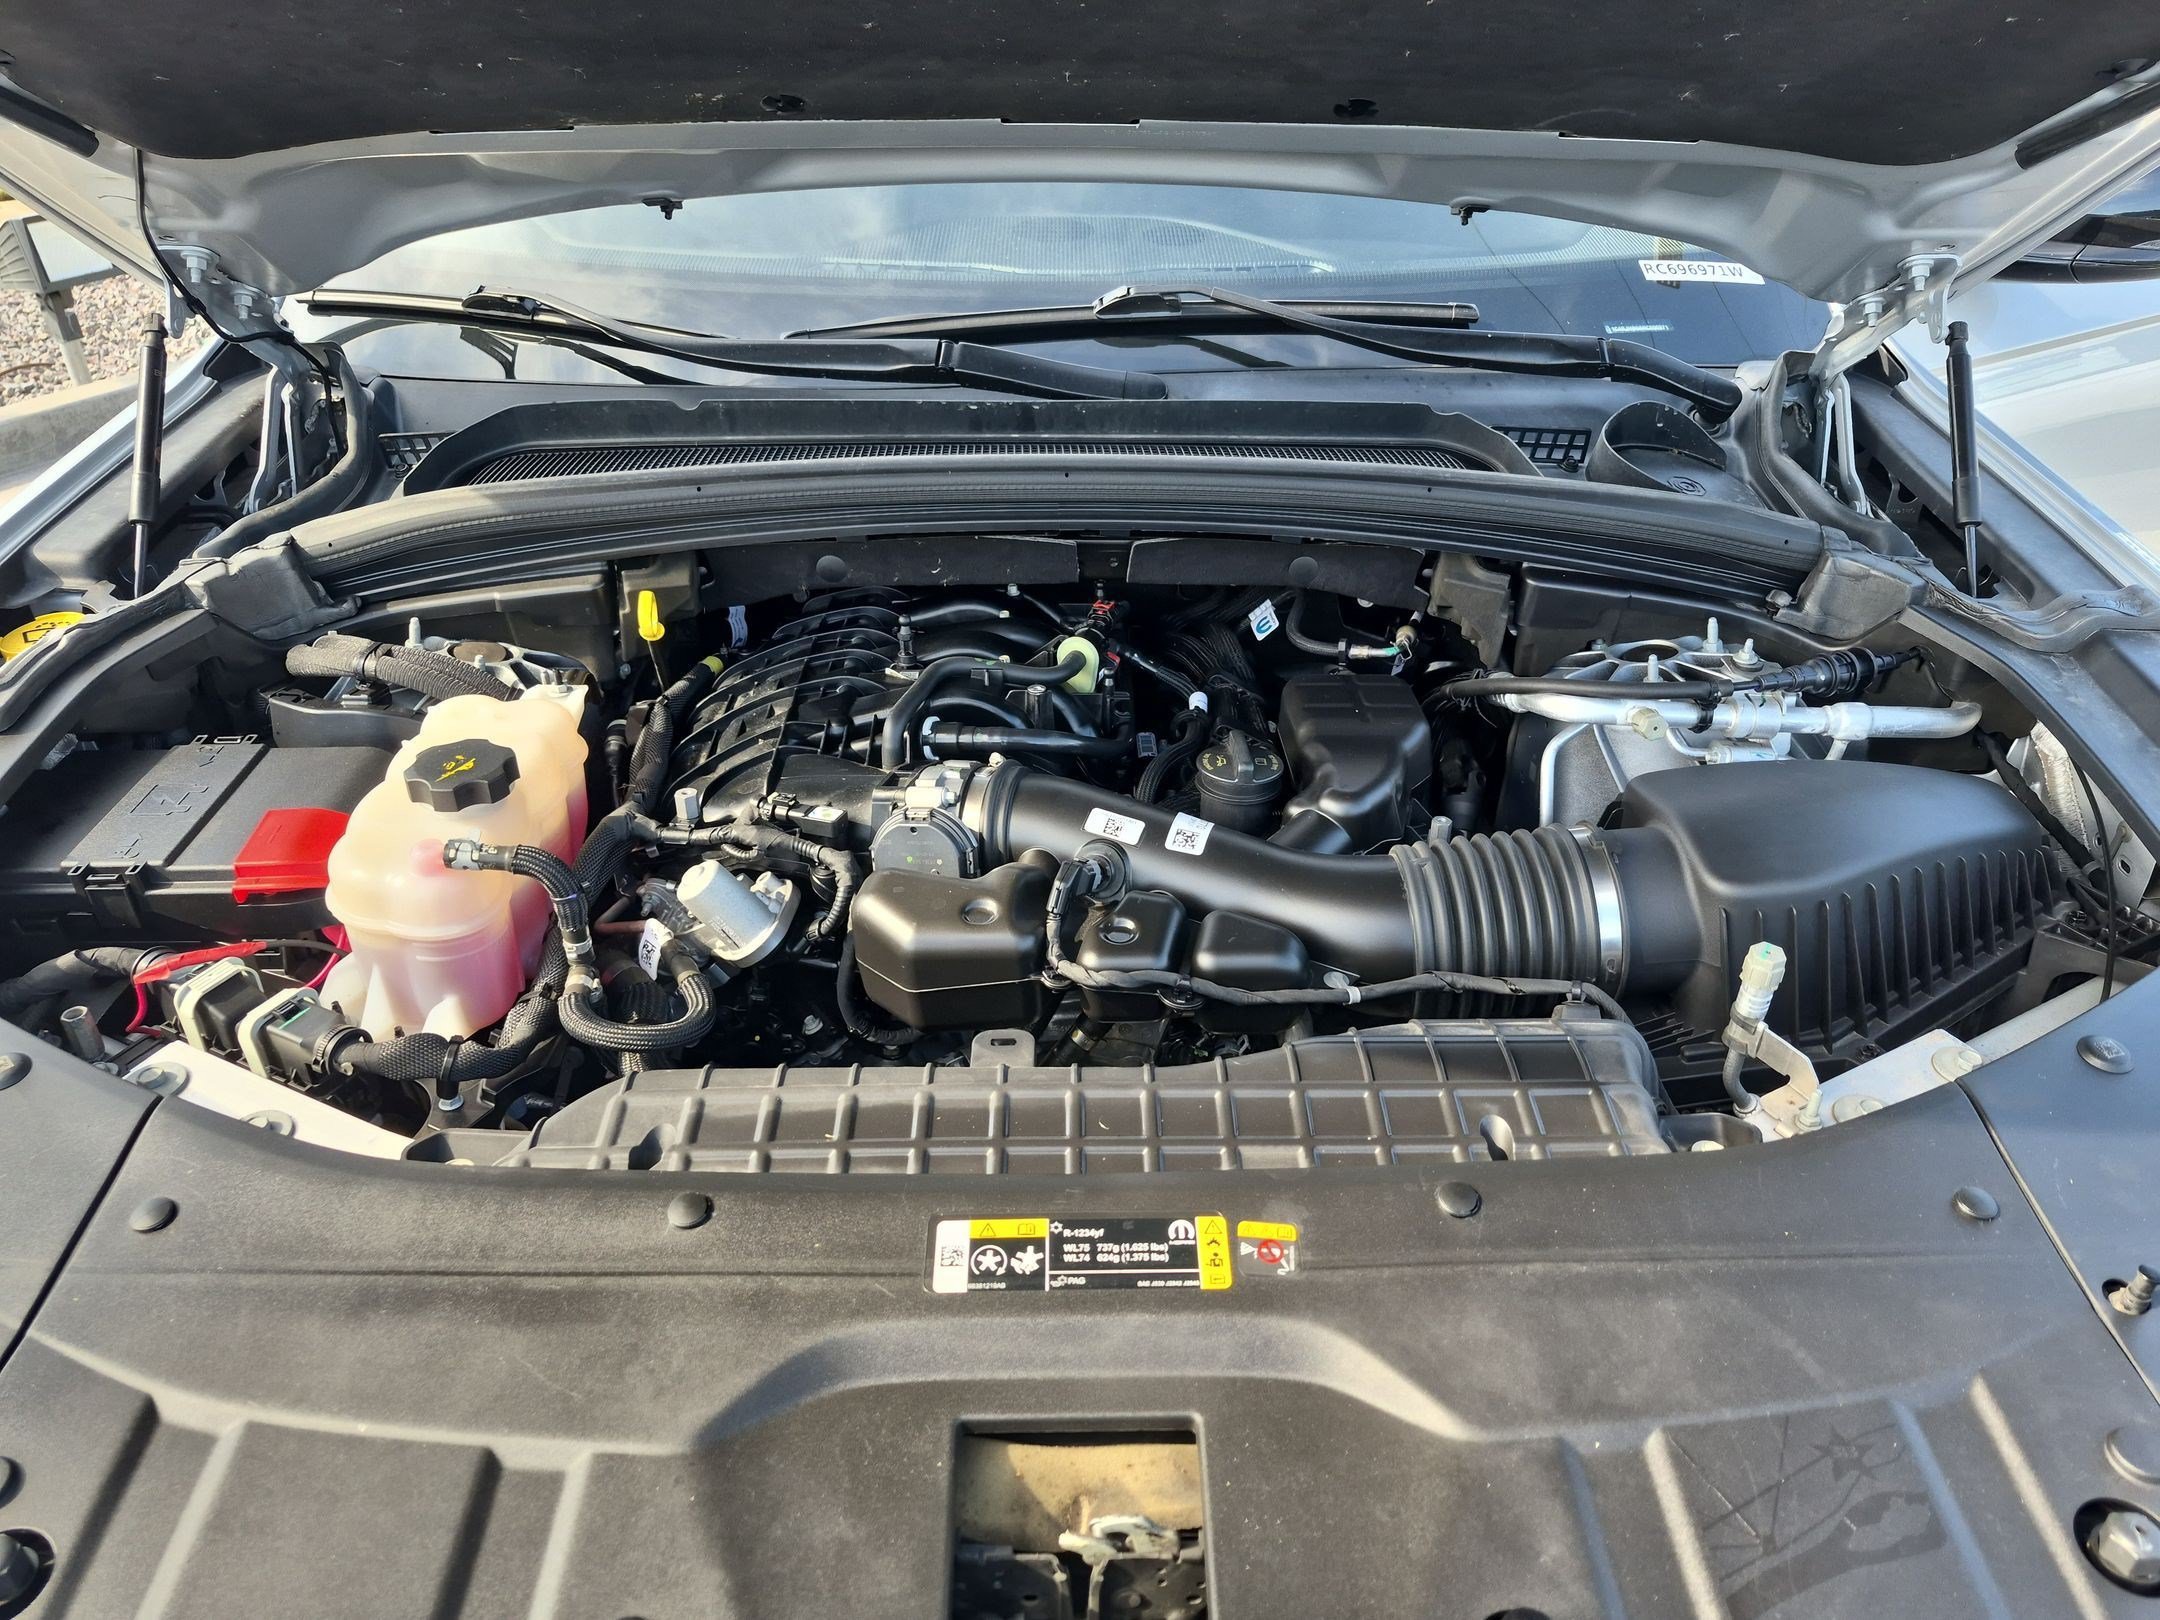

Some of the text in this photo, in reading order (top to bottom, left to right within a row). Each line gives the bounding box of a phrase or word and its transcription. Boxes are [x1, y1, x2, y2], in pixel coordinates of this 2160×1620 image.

[1643, 263, 1743, 277] RC696971W
[1062, 1227, 1105, 1239] R-1234yf
[1062, 1243, 1091, 1253] WL75
[1096, 1243, 1120, 1254] 737g
[1120, 1242, 1149, 1253] (1.625
[1149, 1242, 1169, 1253] lbs)
[1062, 1252, 1170, 1264] WL74 624g (1.375 lbs)
[1067, 1276, 1087, 1285] PAG
